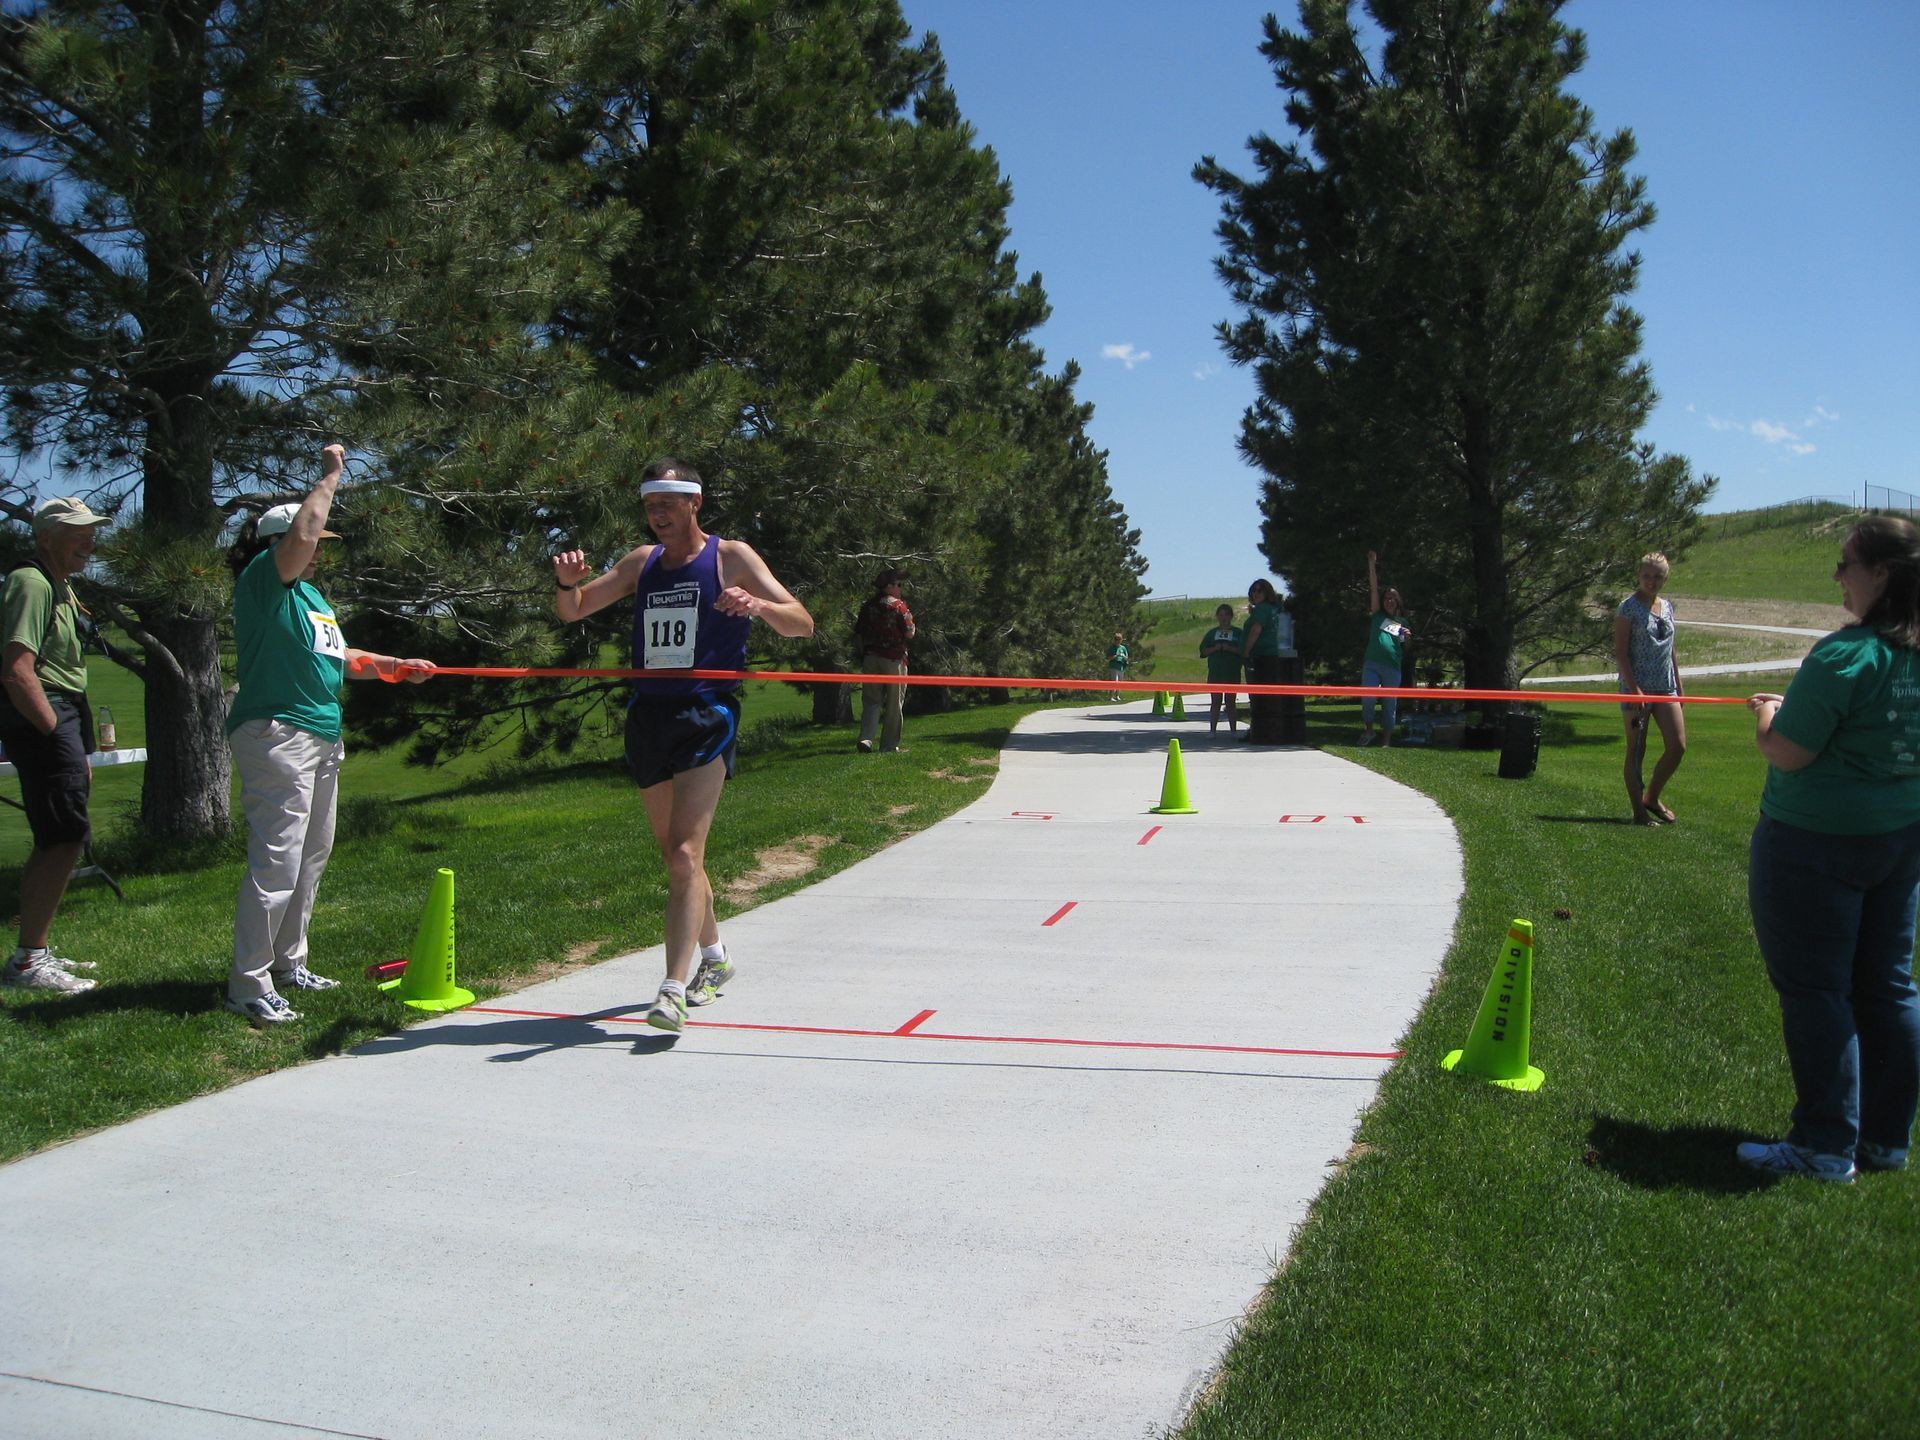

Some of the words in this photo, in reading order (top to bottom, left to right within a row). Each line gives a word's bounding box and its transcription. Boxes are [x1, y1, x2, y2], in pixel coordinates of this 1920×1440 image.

[652, 591, 693, 605] leukemia
[322, 623, 339, 650] 50
[651, 620, 687, 648] 118
[1492, 947, 1522, 1042] DIVISION
